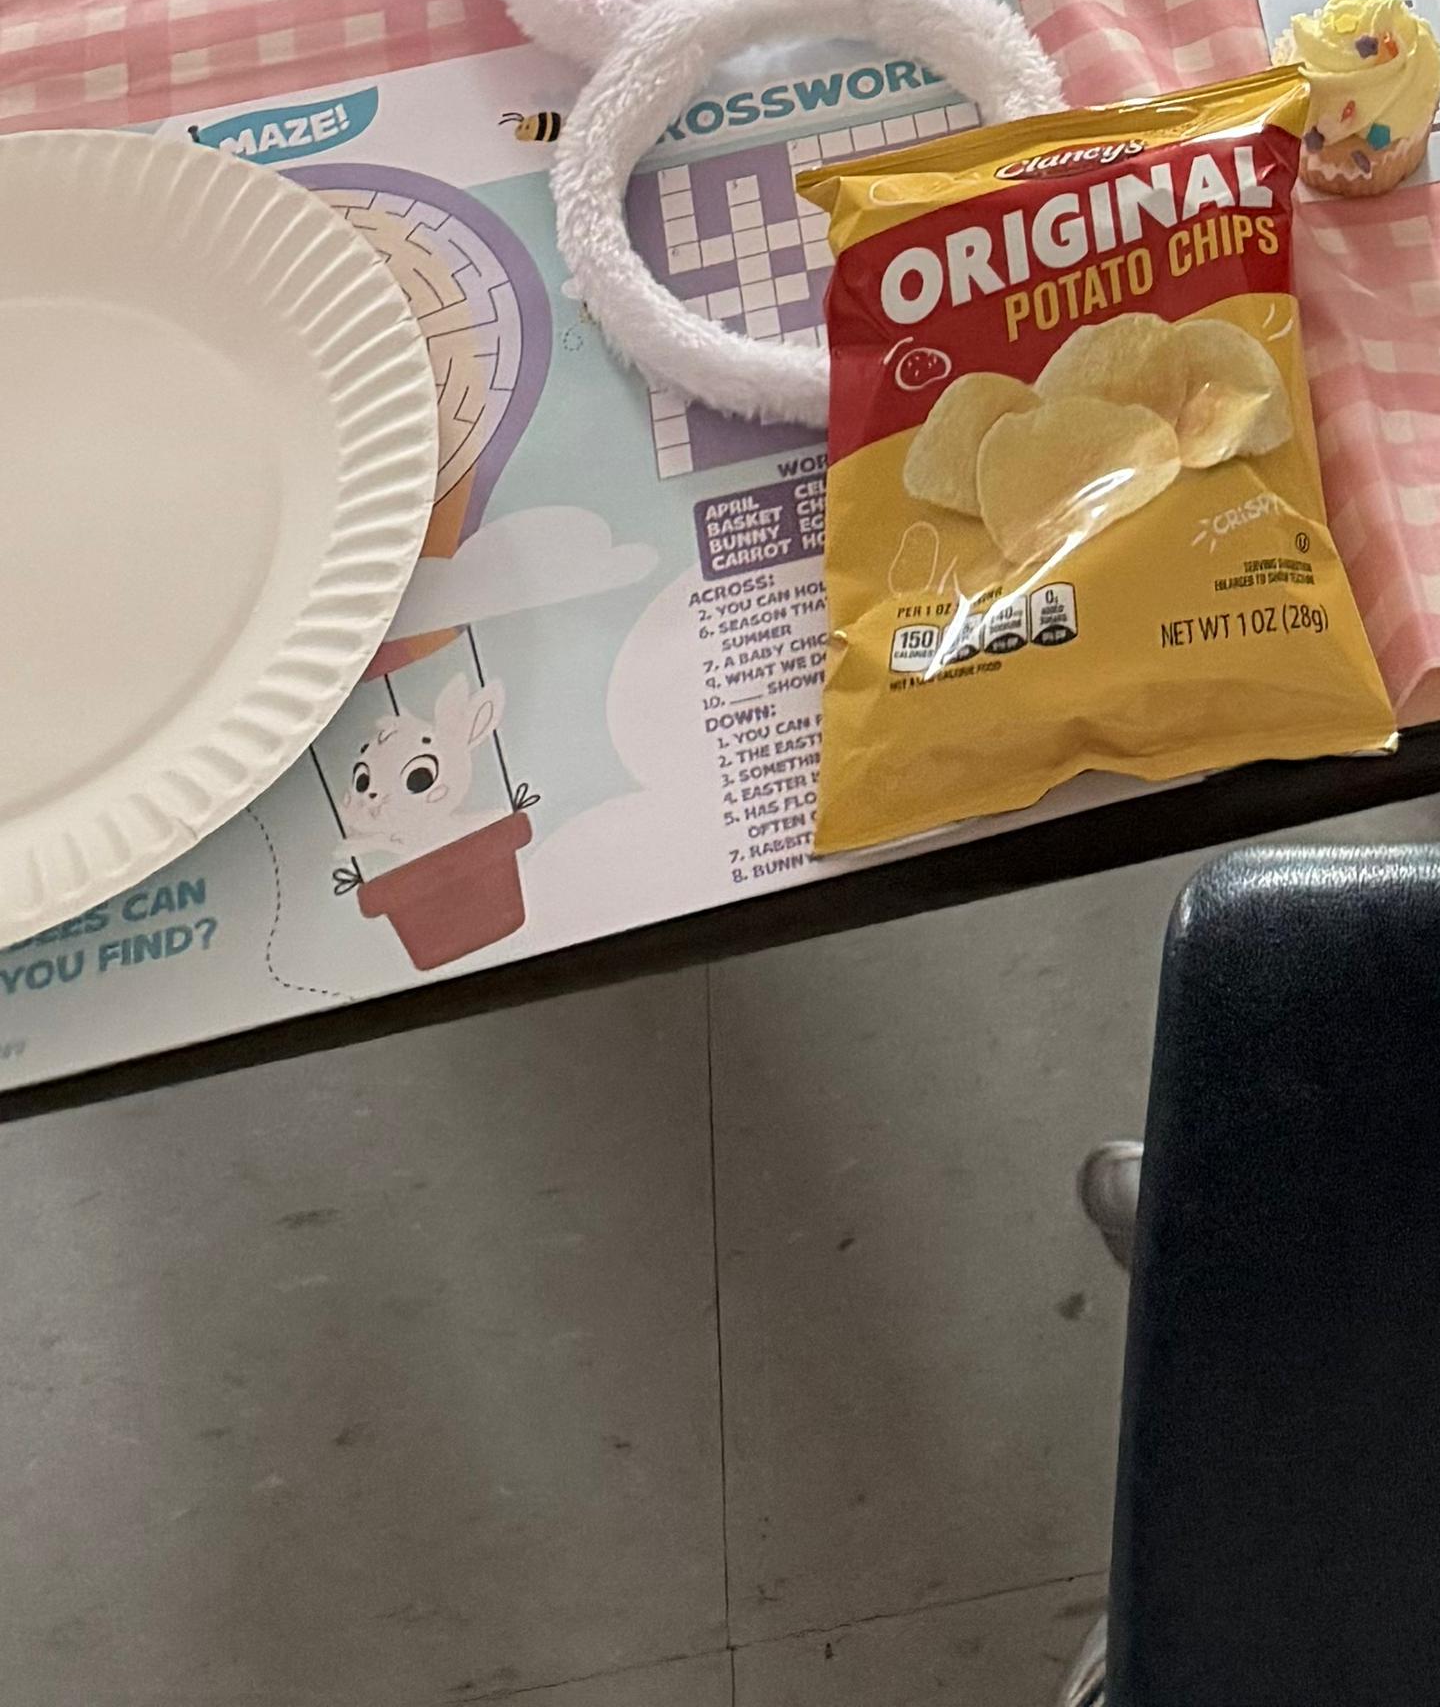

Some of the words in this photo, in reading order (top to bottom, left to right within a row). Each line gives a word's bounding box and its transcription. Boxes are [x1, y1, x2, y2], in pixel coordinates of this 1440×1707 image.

[654, 60, 948, 145] OSSWOR
[218, 102, 351, 156] MAZE!
[879, 144, 1275, 325] ORIGINAL
[1004, 247, 1154, 343] POTATO
[1168, 214, 1279, 279] CHIPS
[793, 479, 827, 499] CEL
[704, 495, 760, 522] APRIL
[706, 505, 784, 538] BASKET
[796, 499, 826, 516] CH
[708, 524, 781, 555] BUNNY
[710, 538, 793, 572] CARROT
[688, 574, 776, 608] ACROSS:
[698, 608, 713, 622] 2.
[715, 597, 753, 618] YOU
[756, 588, 791, 608] CAN
[793, 580, 827, 597] HOL
[935, 602, 952, 615] OZ
[698, 625, 715, 640] 6.
[718, 607, 788, 635] SEASON
[790, 597, 828, 617] THA
[1160, 618, 1194, 649] NET
[1198, 613, 1231, 641] WT
[1236, 612, 1247, 637] 1
[1251, 607, 1278, 635] OZ
[1282, 603, 1330, 635] (28g)
[702, 659, 720, 674] 7.
[723, 656, 736, 669] A
[738, 643, 785, 667] BABY
[789, 632, 828, 653] CHIC
[721, 623, 793, 652] SUMMER
[900, 629, 935, 649] 150
[702, 695, 726, 711] 10.
[767, 669, 826, 695] SHOW
[705, 676, 722, 690] 9.
[725, 662, 777, 686] WHAT
[779, 655, 808, 672] WE
[705, 703, 778, 733] DOWN:
[717, 737, 730, 750] 1.
[733, 725, 771, 745] YOU
[775, 715, 811, 736] CAN
[718, 755, 733, 769] 2.
[736, 743, 771, 765] THE
[774, 731, 823, 755] EAST
[721, 773, 736, 787] 3.
[722, 792, 738, 805] 4.
[740, 774, 808, 803] EASTER
[723, 812, 741, 826] 5.
[743, 800, 780, 822] HAS
[783, 790, 818, 812] FLO
[747, 811, 807, 840] OFTEN
[728, 848, 746, 865] 7.
[749, 830, 814, 860] RABBIT
[731, 867, 749, 884] 8.
[121, 877, 207, 923] CAN
[0, 950, 85, 996] YOU
[97, 916, 219, 973] FIND?
